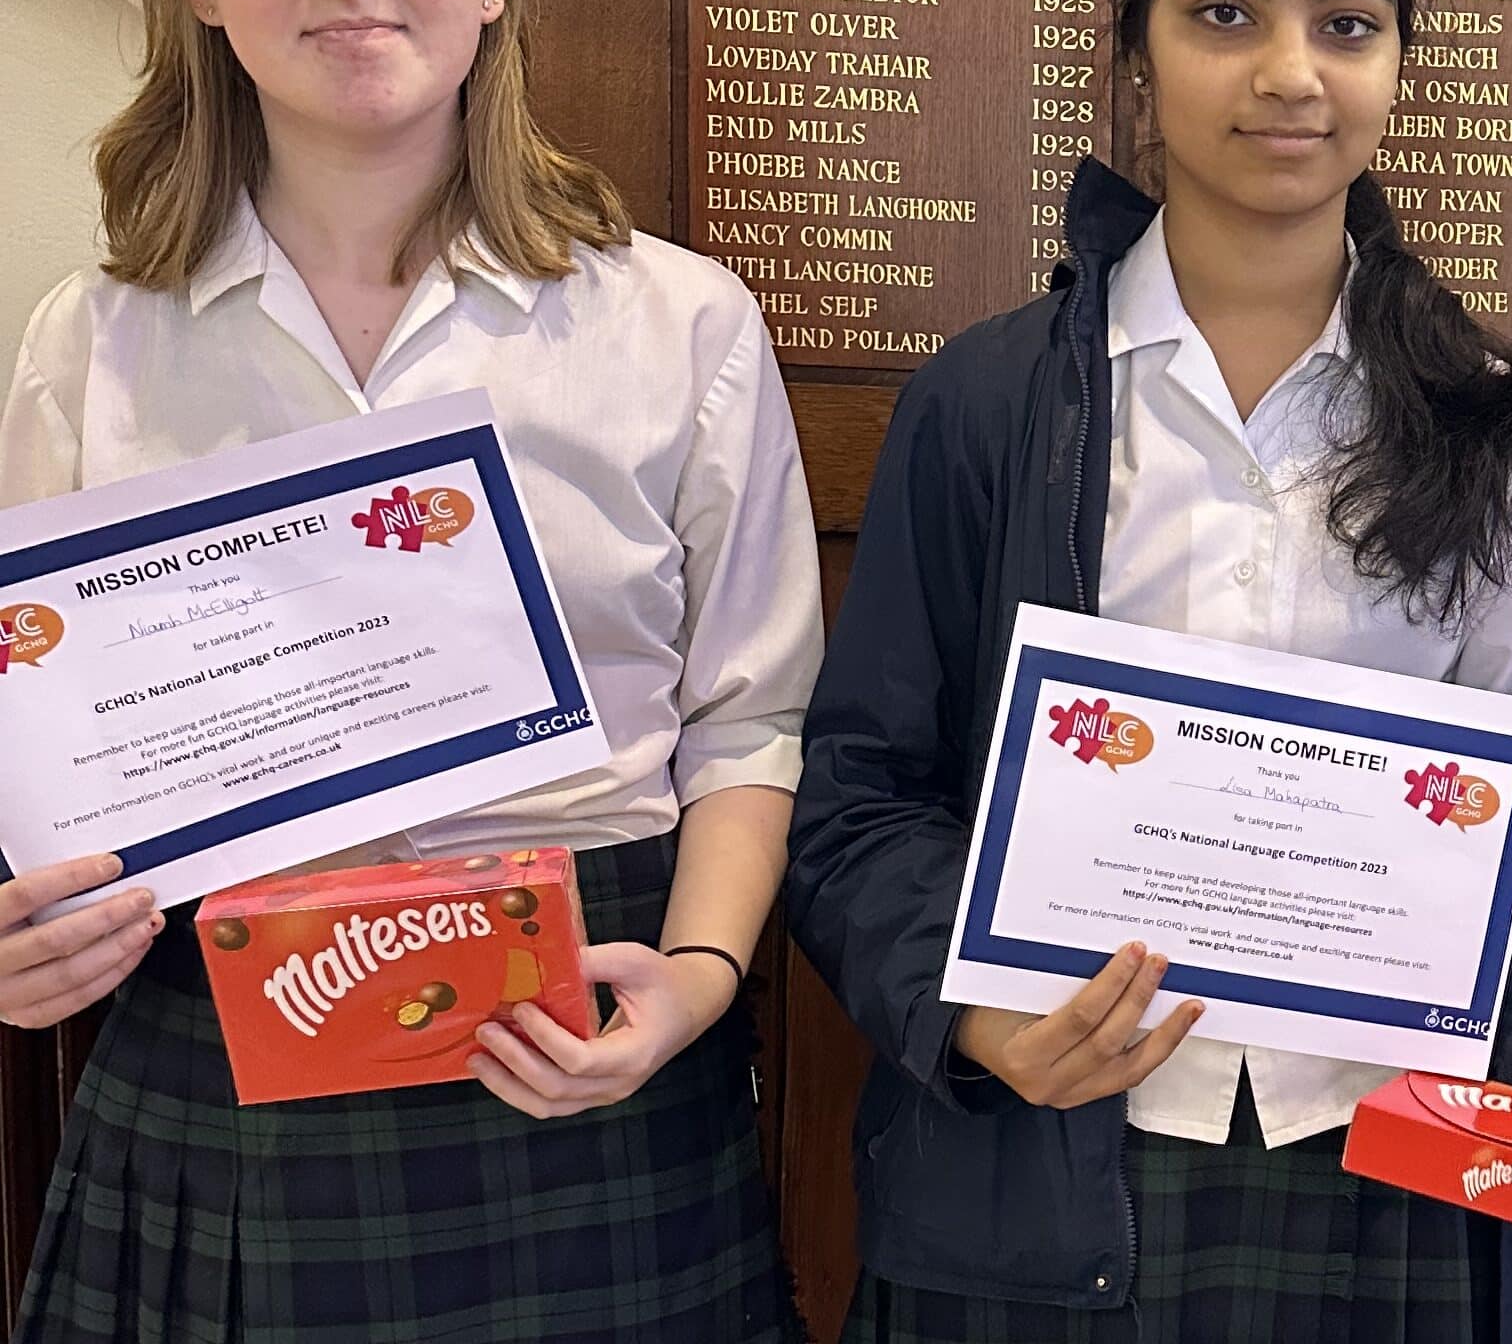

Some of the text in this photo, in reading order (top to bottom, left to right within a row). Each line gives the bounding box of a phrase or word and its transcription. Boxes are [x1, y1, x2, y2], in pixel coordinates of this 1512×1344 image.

[706, 7, 1095, 50] VIOLET OLVER 1926
[707, 45, 1093, 88] LOVEDAY TRAHAIR 1927
[706, 79, 1093, 122] MOLLIE ZAMBRA 1928
[1426, 81, 1508, 106] OSMAN
[708, 115, 1092, 156] ENID MILLS 1929
[708, 151, 900, 183] PHOEBE NANCE
[708, 188, 975, 222] ELISABETH LANGHORNE
[1403, 221, 1503, 246] HOOPER
[380, 492, 458, 533] NLC
[429, 520, 458, 532] GCHQ
[76, 513, 327, 599] MISSION COMPLETE!
[187, 572, 241, 593] Thank you
[95, 616, 389, 713] GCHQ's National Language Competition 2023
[1072, 712, 1139, 746] NLC
[1178, 721, 1387, 771] MISSION COMPLETE!
[221, 742, 341, 788] www.gchq-careers.co.uk
[1106, 746, 1133, 756] GCHQ
[1426, 775, 1486, 807] NLC
[1456, 808, 1480, 818] GCHQ
[1135, 824, 1387, 874] GCHQ's National Language Competition 2023
[264, 903, 491, 1036] Maltesers
